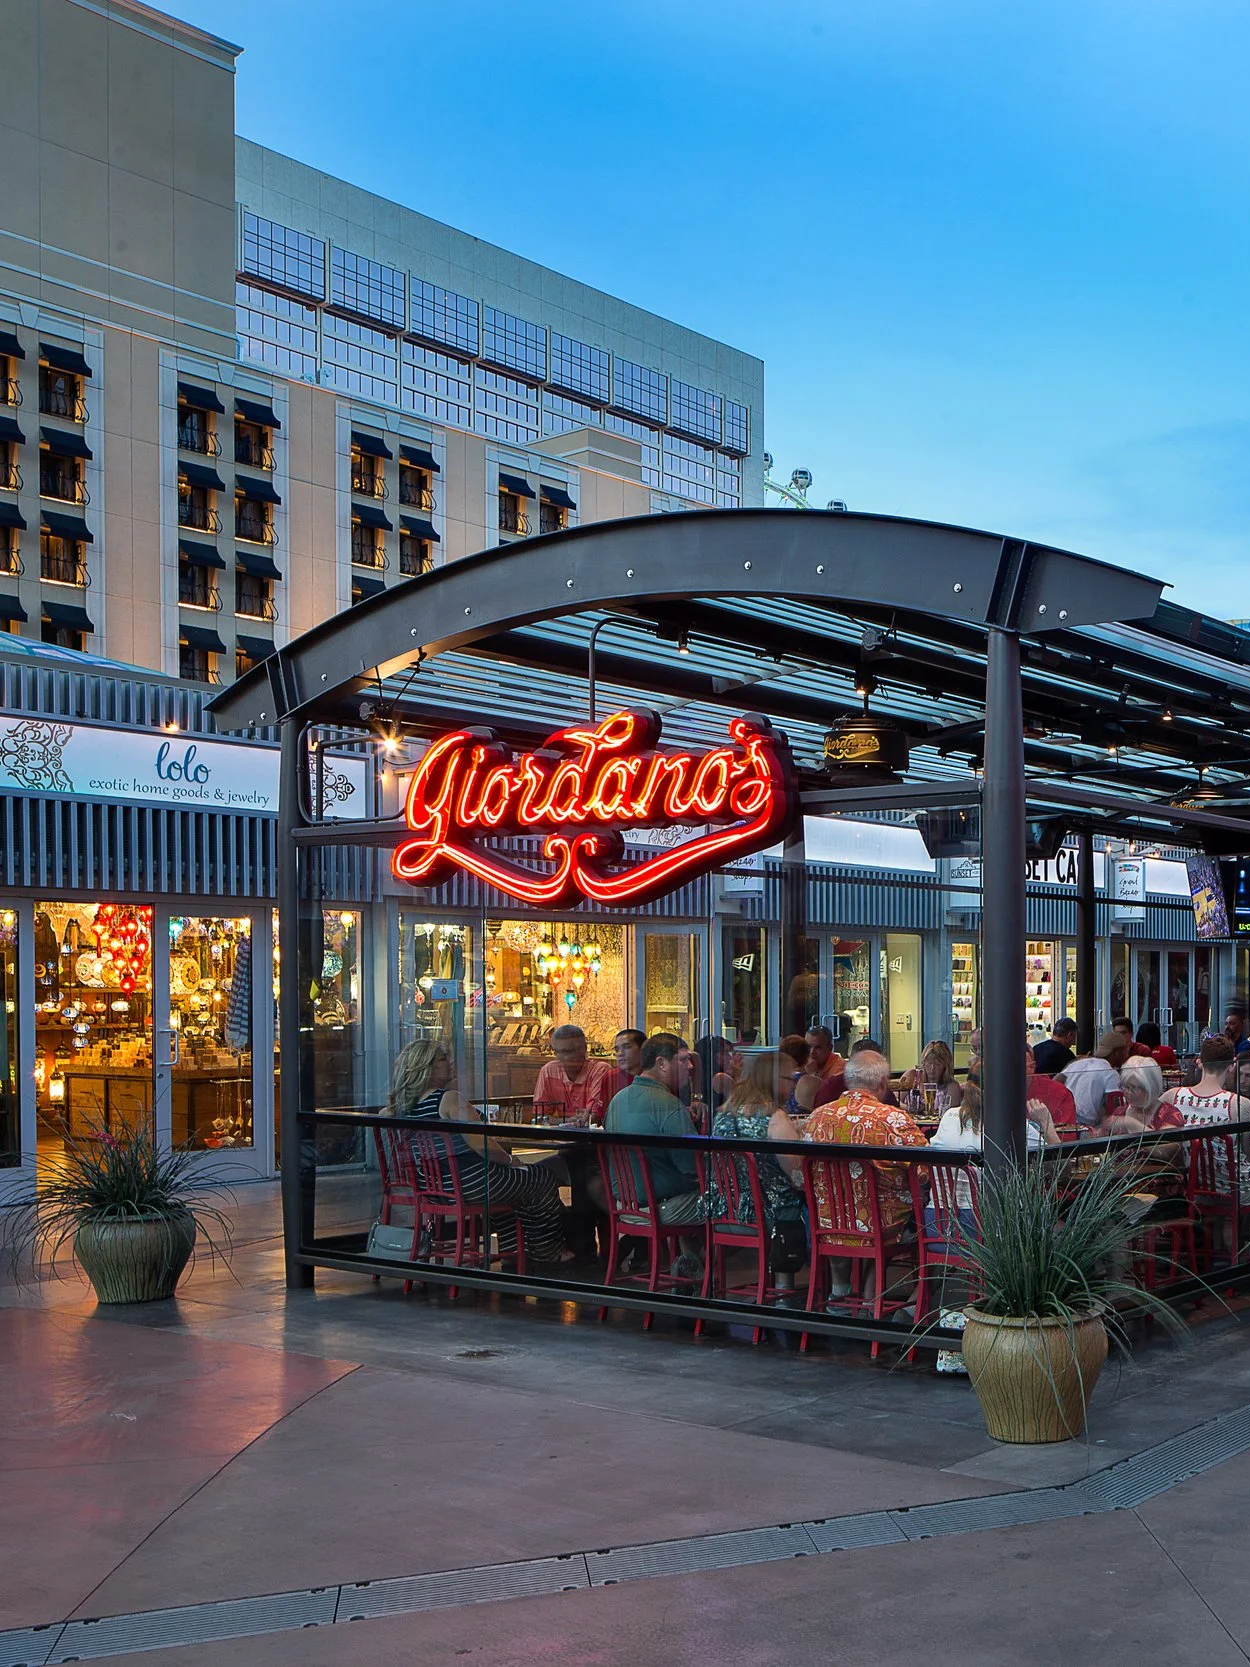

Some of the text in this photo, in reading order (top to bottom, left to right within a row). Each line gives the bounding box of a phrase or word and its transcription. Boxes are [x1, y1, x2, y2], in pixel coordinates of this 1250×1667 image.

[155, 741, 211, 784] lolo
[89, 778, 269, 808] exotic home goods & jewelry
[392, 707, 773, 888] Giordano's
